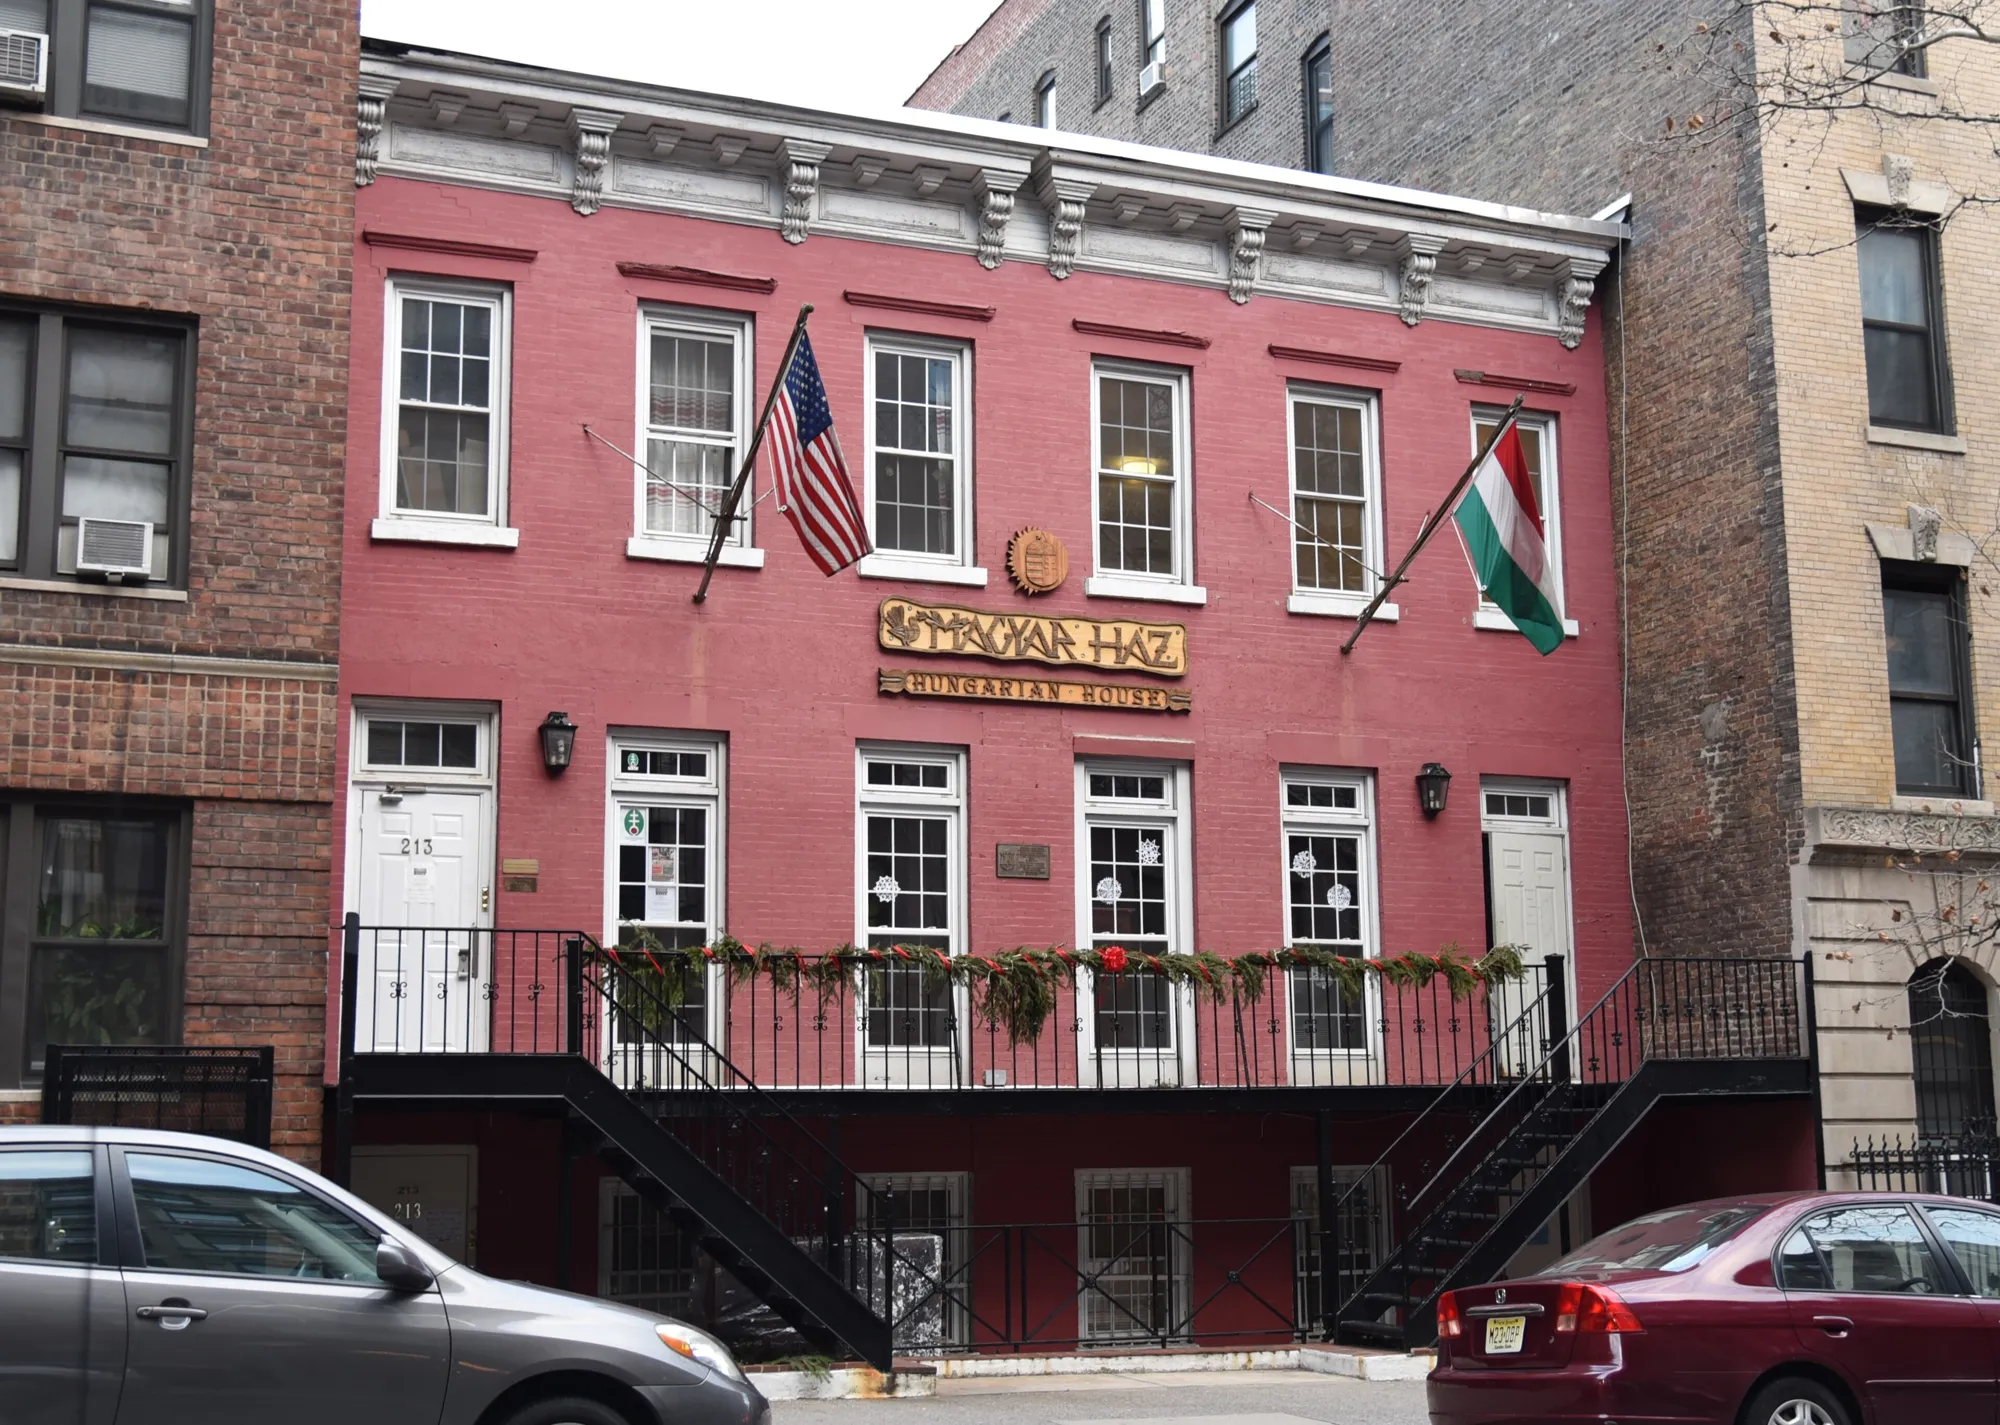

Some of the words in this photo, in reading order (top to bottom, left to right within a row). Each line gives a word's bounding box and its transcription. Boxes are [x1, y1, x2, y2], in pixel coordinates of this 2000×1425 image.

[929, 612, 1077, 660] MAGYAR
[912, 674, 1060, 700] HUNGARIAN
[1083, 686, 1161, 705] HOUSE
[401, 838, 432, 855] 213
[394, 1203, 421, 1219] 213
